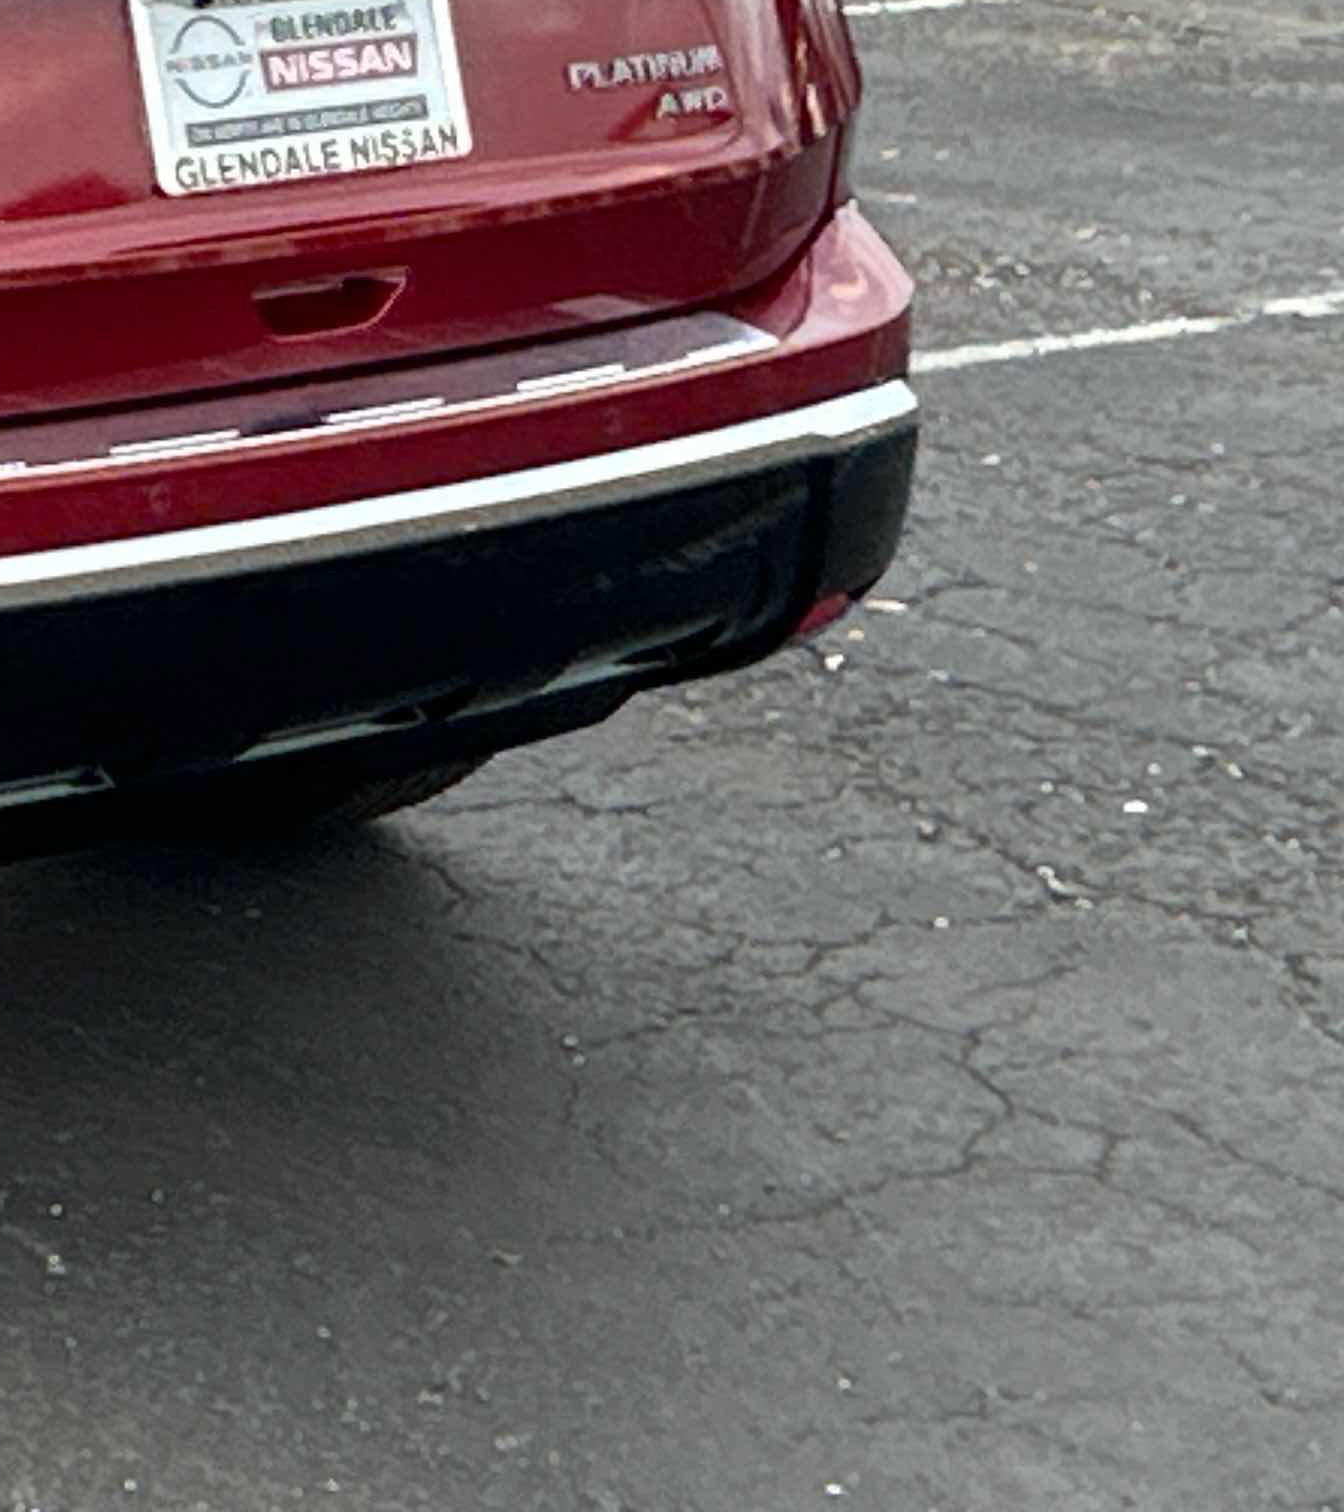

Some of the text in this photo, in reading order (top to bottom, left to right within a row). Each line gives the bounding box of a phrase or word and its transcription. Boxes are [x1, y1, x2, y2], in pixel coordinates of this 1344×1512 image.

[269, 7, 399, 43] GLENDALE
[266, 40, 413, 87] NISSAN
[567, 43, 725, 89] PLATINUM
[655, 86, 732, 120] AWD
[174, 124, 460, 191] GLENDALE NISSAN
